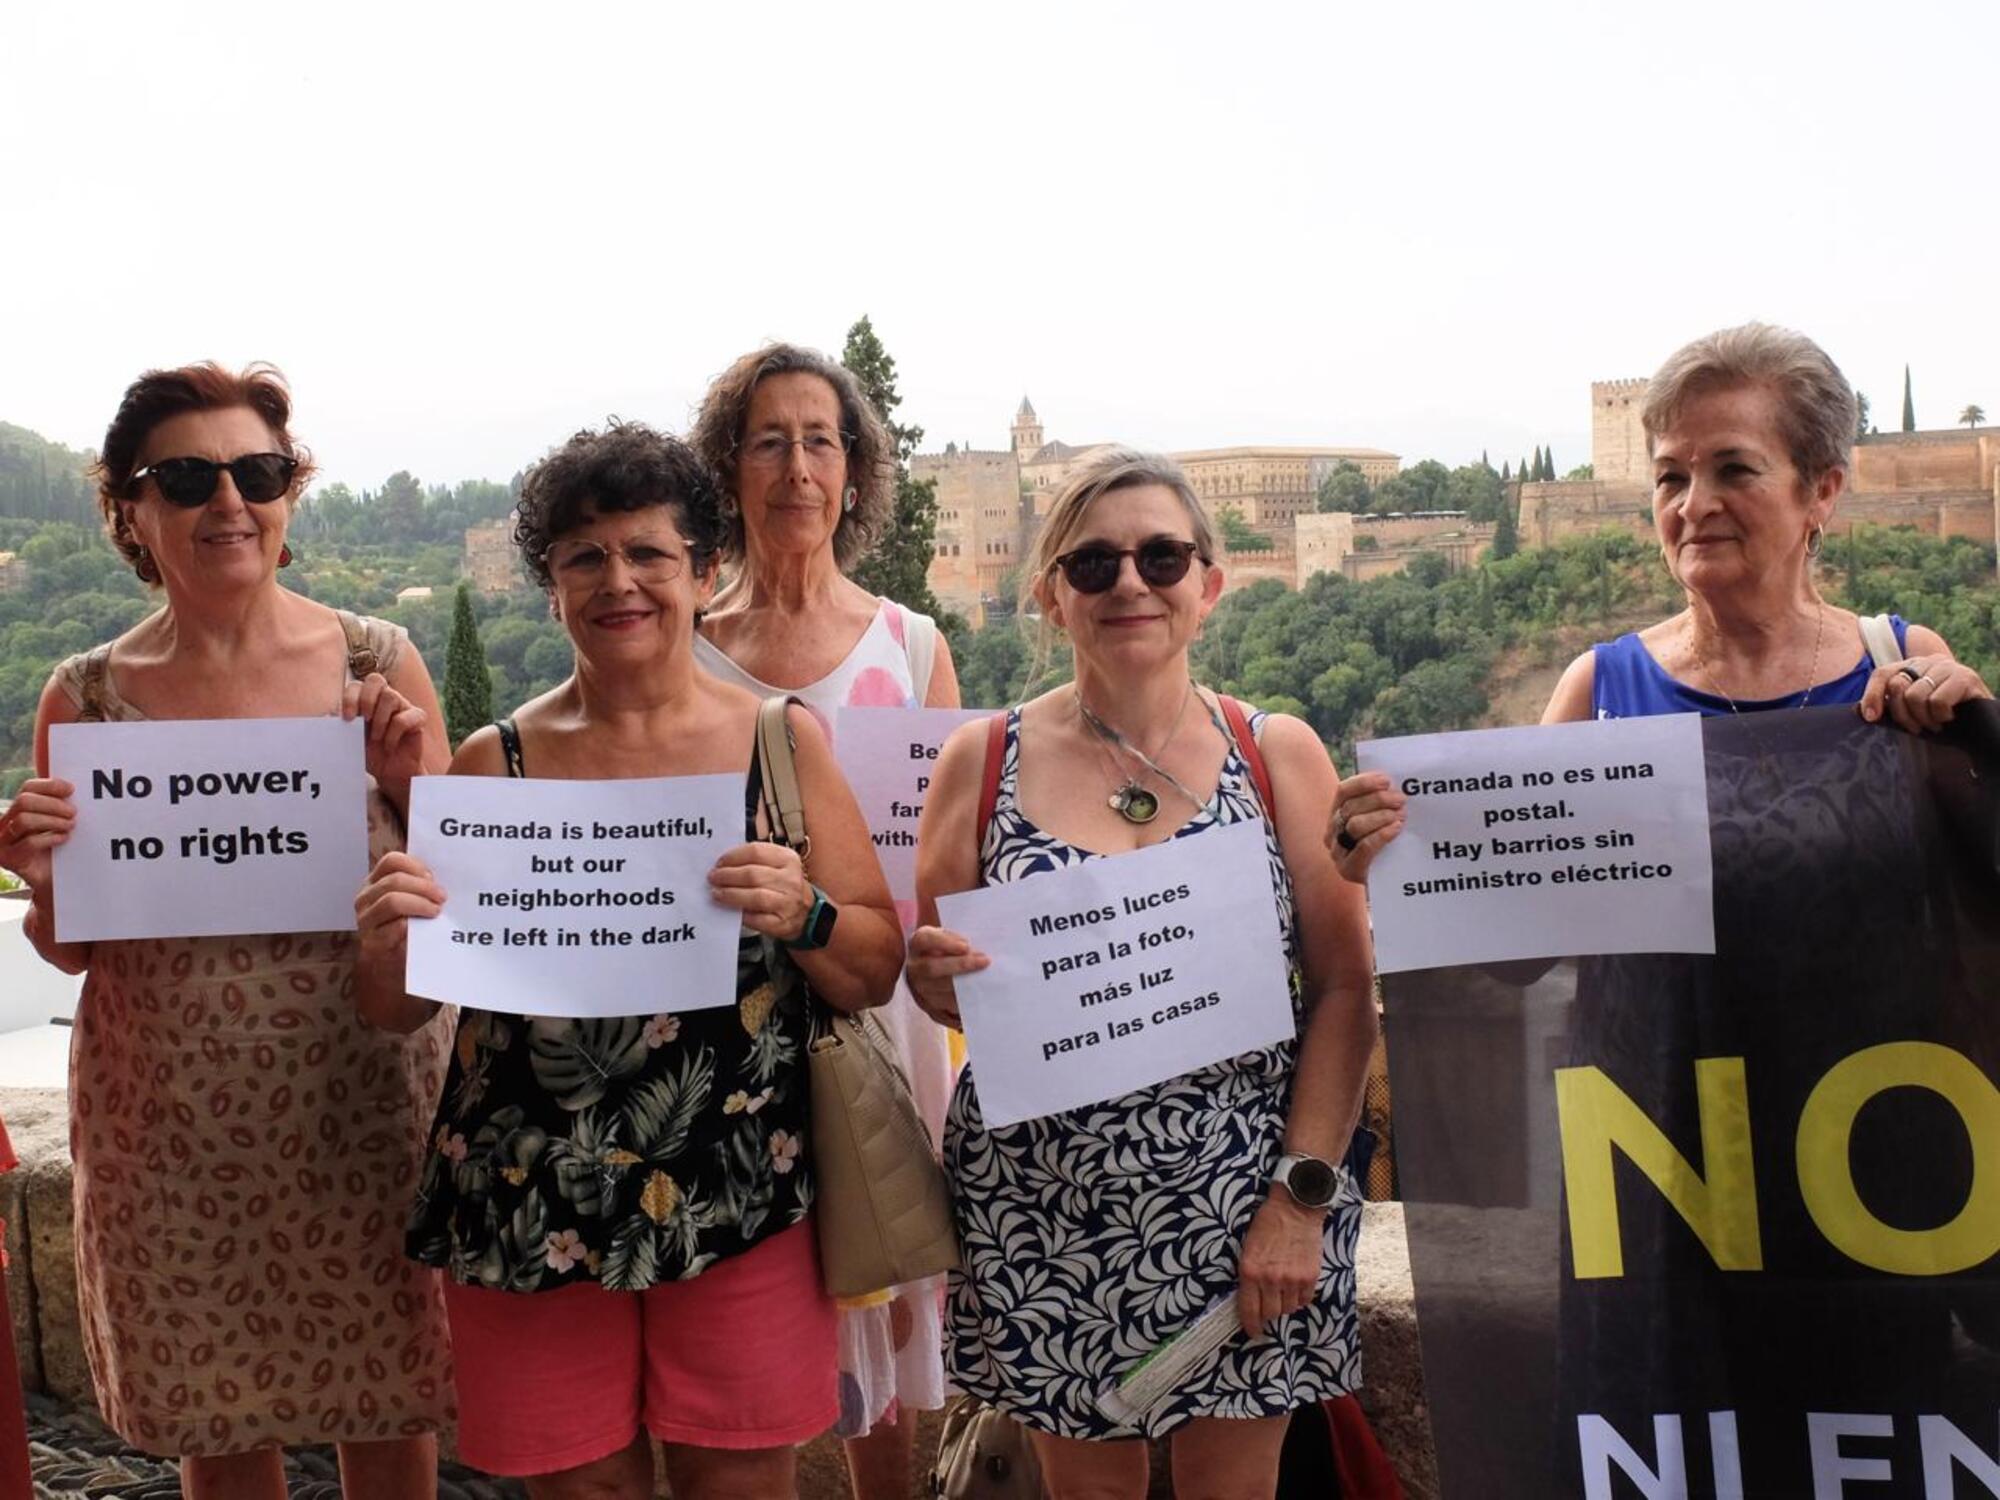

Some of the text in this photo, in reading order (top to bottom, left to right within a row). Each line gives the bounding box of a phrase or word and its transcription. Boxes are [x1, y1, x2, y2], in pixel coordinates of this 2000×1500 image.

[92, 768, 321, 805] No power,
[1401, 762, 1654, 797] Granada no es una
[439, 817, 713, 841] Granada is beautiful,
[1483, 800, 1575, 828] postal.
[110, 825, 309, 865] no rights
[1432, 830, 1635, 862] Hay barrios sin
[531, 854, 627, 874] but our
[1402, 862, 1673, 897] suministro eléctrico
[477, 886, 676, 912] neighborhoods
[1029, 884, 1190, 937] Menos luces
[451, 922, 697, 947] are left in the dark
[1041, 925, 1195, 981] para la foto,
[1079, 967, 1174, 1008] más luz
[1042, 991, 1221, 1062] para las casas
[1554, 1041, 2000, 1279] NO
[1576, 1410, 1744, 1500] NI
